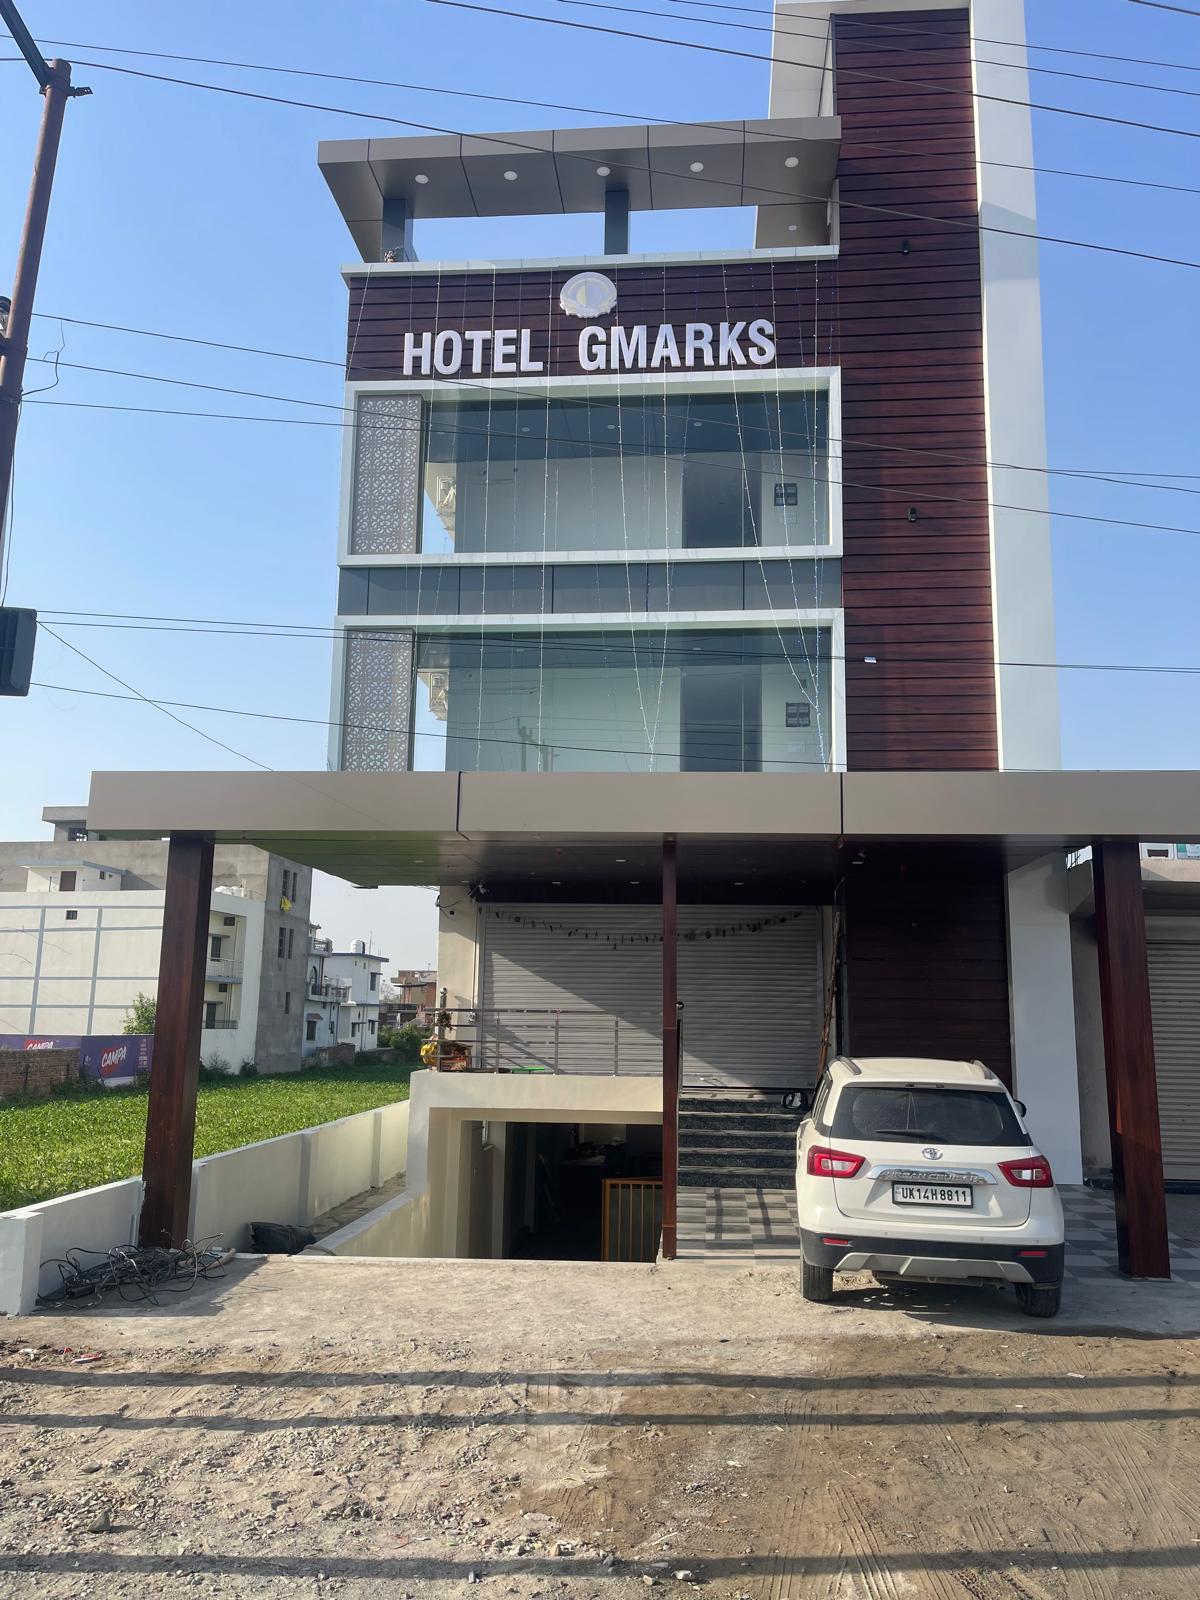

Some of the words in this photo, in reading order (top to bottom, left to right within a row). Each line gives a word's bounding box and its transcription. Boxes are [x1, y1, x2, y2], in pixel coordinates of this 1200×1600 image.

[403, 328, 544, 376] HOTEL
[578, 319, 776, 372] GMARKS
[101, 1046, 127, 1068] CAMPA
[901, 1187, 967, 1202] UK14H8811
